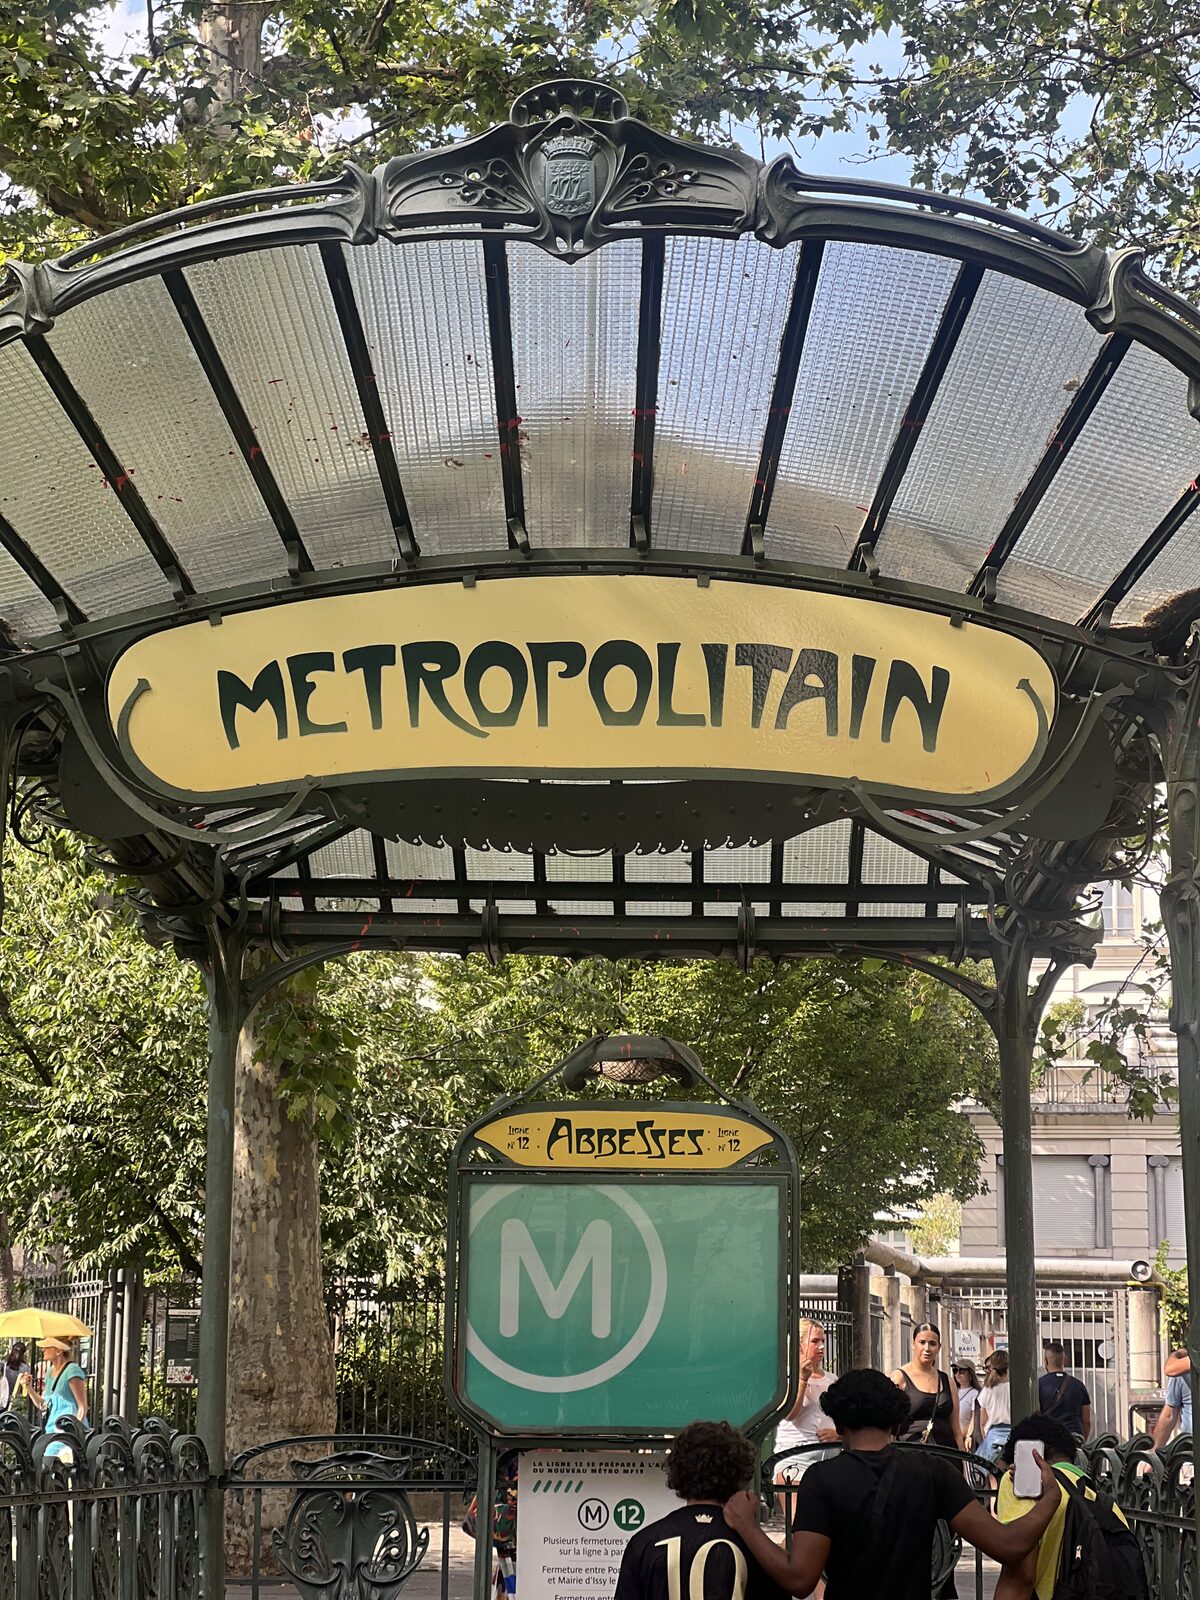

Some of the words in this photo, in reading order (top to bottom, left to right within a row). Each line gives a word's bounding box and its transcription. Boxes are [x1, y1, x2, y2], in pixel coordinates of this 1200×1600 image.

[217, 640, 950, 754] METROPOLITAIN
[516, 1136, 530, 1150] 12
[546, 1117, 705, 1161] ABBESSES
[727, 1138, 741, 1152] 12
[500, 1218, 612, 1339] M
[585, 1505, 602, 1524] M
[617, 1505, 640, 1525] 12
[543, 1536, 579, 1546] Plusieurs
[580, 1536, 624, 1546] fermetures
[573, 1547, 581, 1556] la
[582, 1547, 602, 1558] ligne
[603, 1548, 609, 1556] à
[542, 1565, 583, 1574] Fermeture
[584, 1566, 606, 1574] entre
[654, 1536, 748, 1600] 10
[547, 1576, 556, 1585] et
[558, 1576, 584, 1585] Mairie
[585, 1576, 607, 1587] d'Issy
